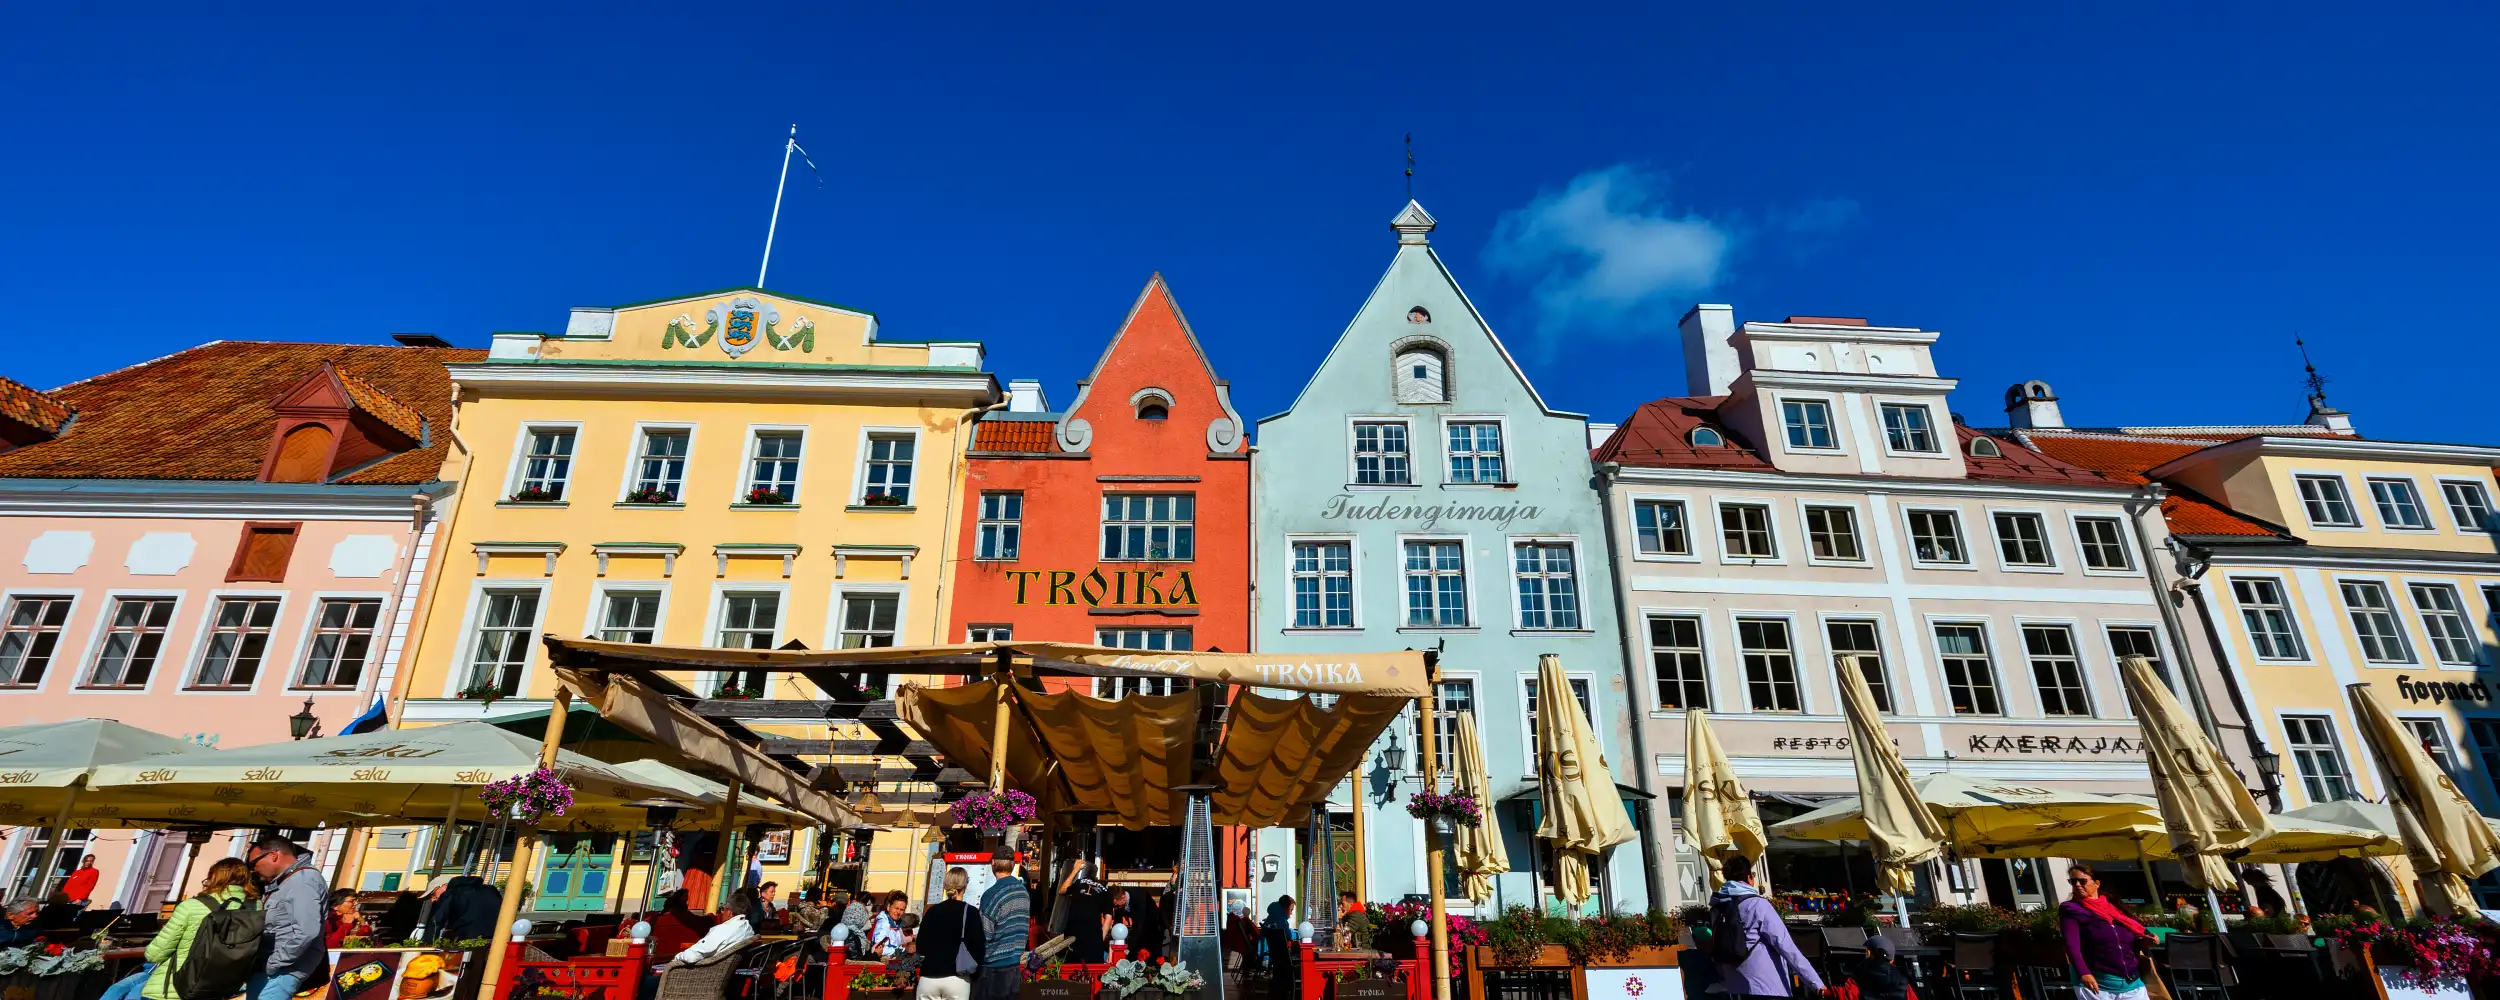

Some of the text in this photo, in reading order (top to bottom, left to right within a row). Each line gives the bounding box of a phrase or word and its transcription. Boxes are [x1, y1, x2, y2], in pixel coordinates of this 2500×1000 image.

[1321, 493, 1546, 532] Tudengimaja
[1005, 564, 1200, 608] TROIKA
[1255, 660, 1365, 687] TROIKA
[1968, 734, 2145, 754] KAERAJA
[136, 768, 178, 783] saku
[240, 766, 284, 781] saku
[350, 766, 391, 781] saku
[453, 768, 496, 784] saku
